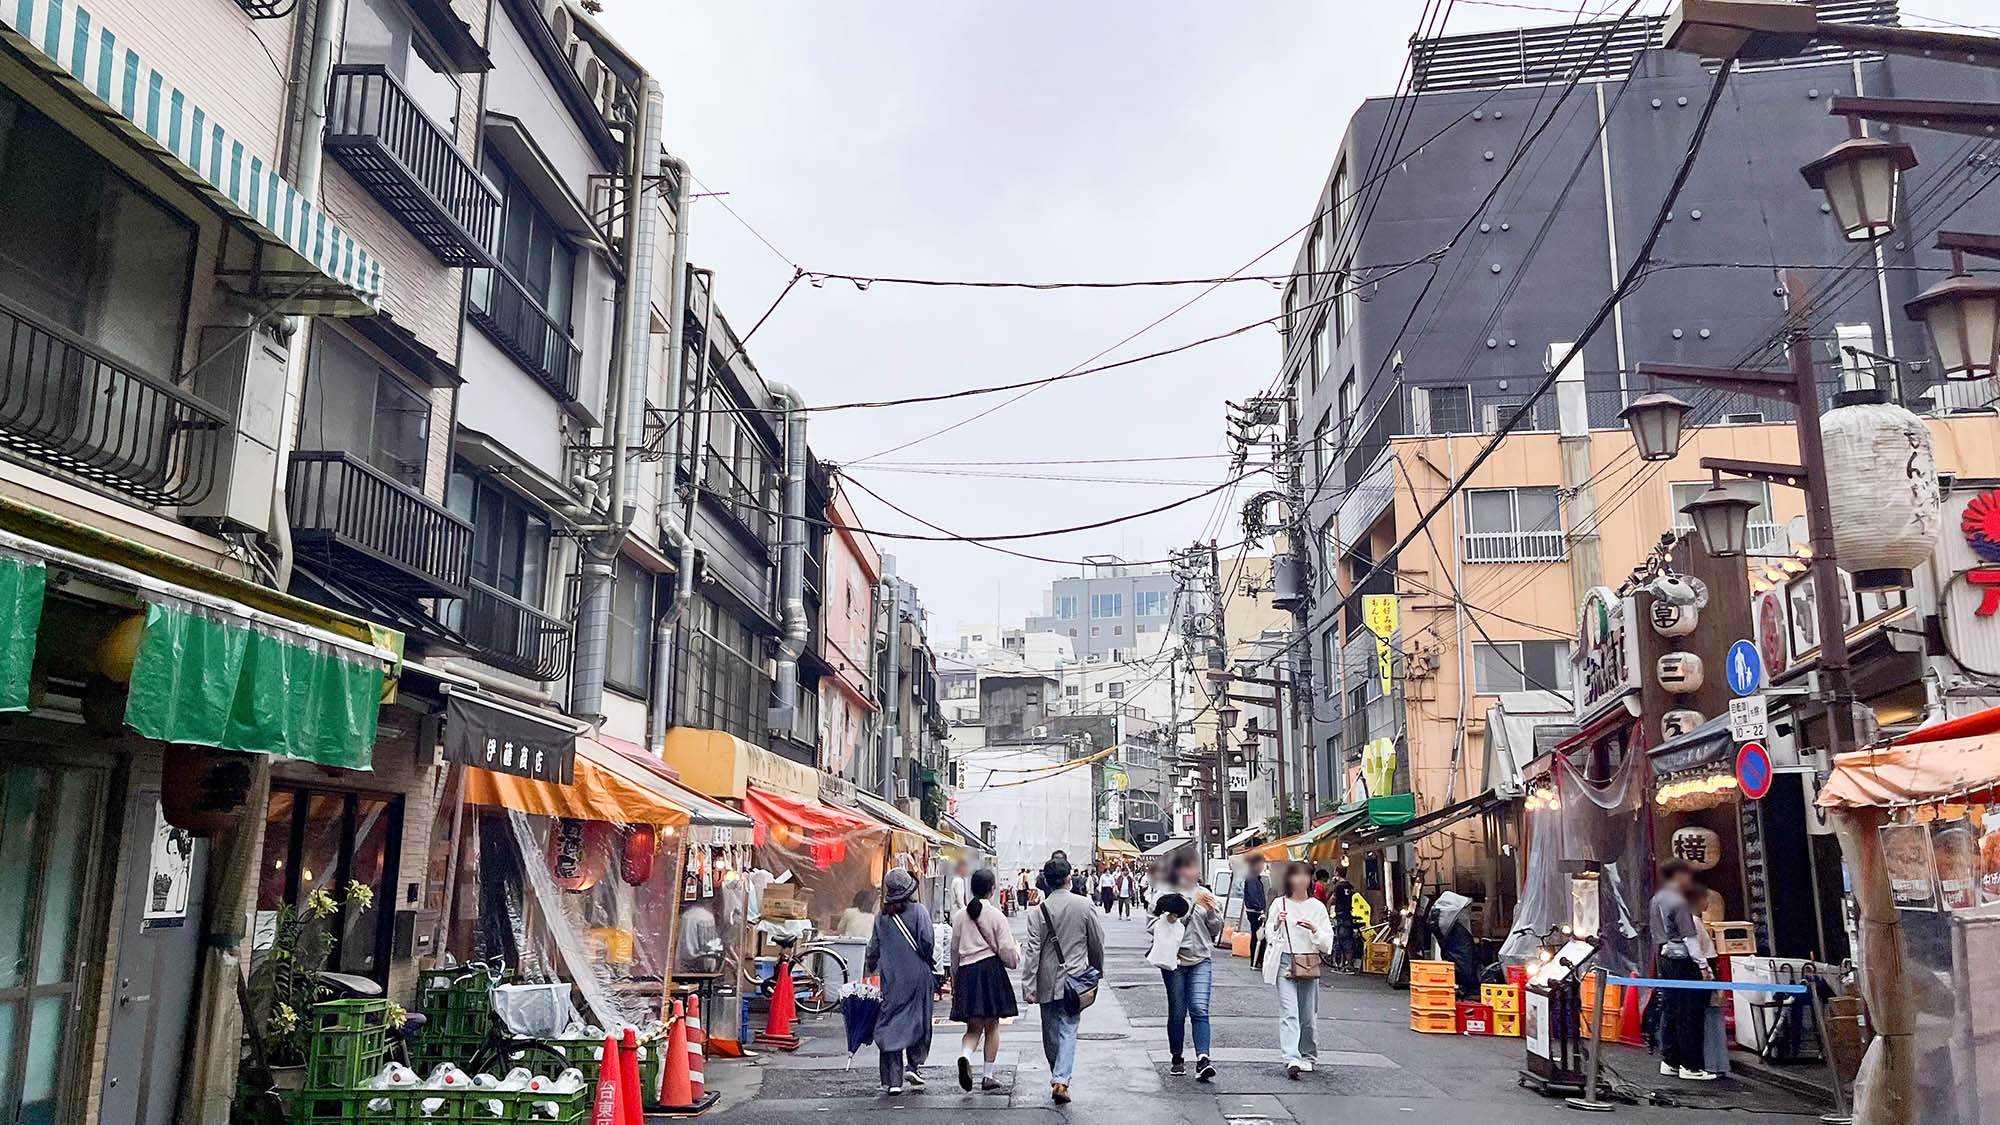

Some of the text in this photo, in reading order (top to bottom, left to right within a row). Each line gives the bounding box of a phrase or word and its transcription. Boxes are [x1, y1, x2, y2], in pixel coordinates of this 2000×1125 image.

[1379, 636, 1390, 679] つくし
[1673, 834, 1706, 864] 横
